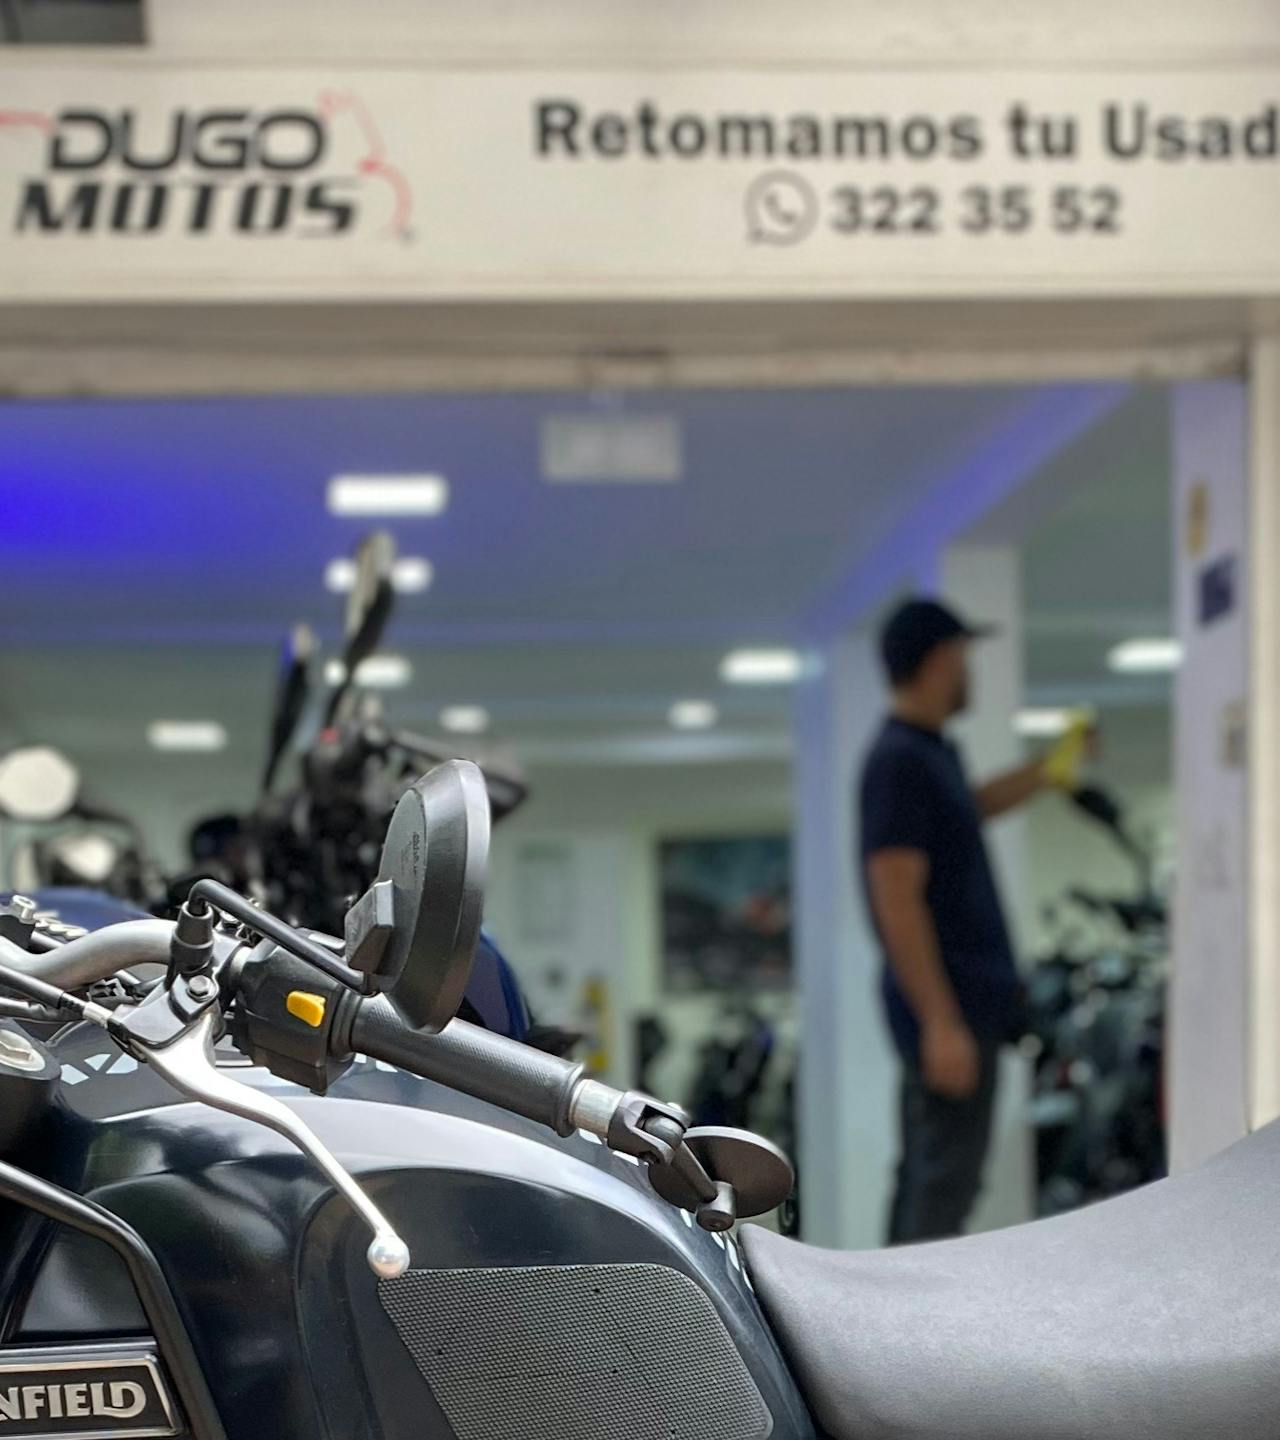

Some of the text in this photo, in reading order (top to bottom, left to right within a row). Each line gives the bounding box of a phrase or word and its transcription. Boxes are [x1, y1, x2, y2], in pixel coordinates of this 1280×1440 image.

[45, 109, 328, 172] DUGO
[534, 100, 984, 160] Retomamos
[1008, 100, 1078, 160] tu
[14, 176, 363, 238] MOTOS
[828, 185, 1127, 234] 322 35 52
